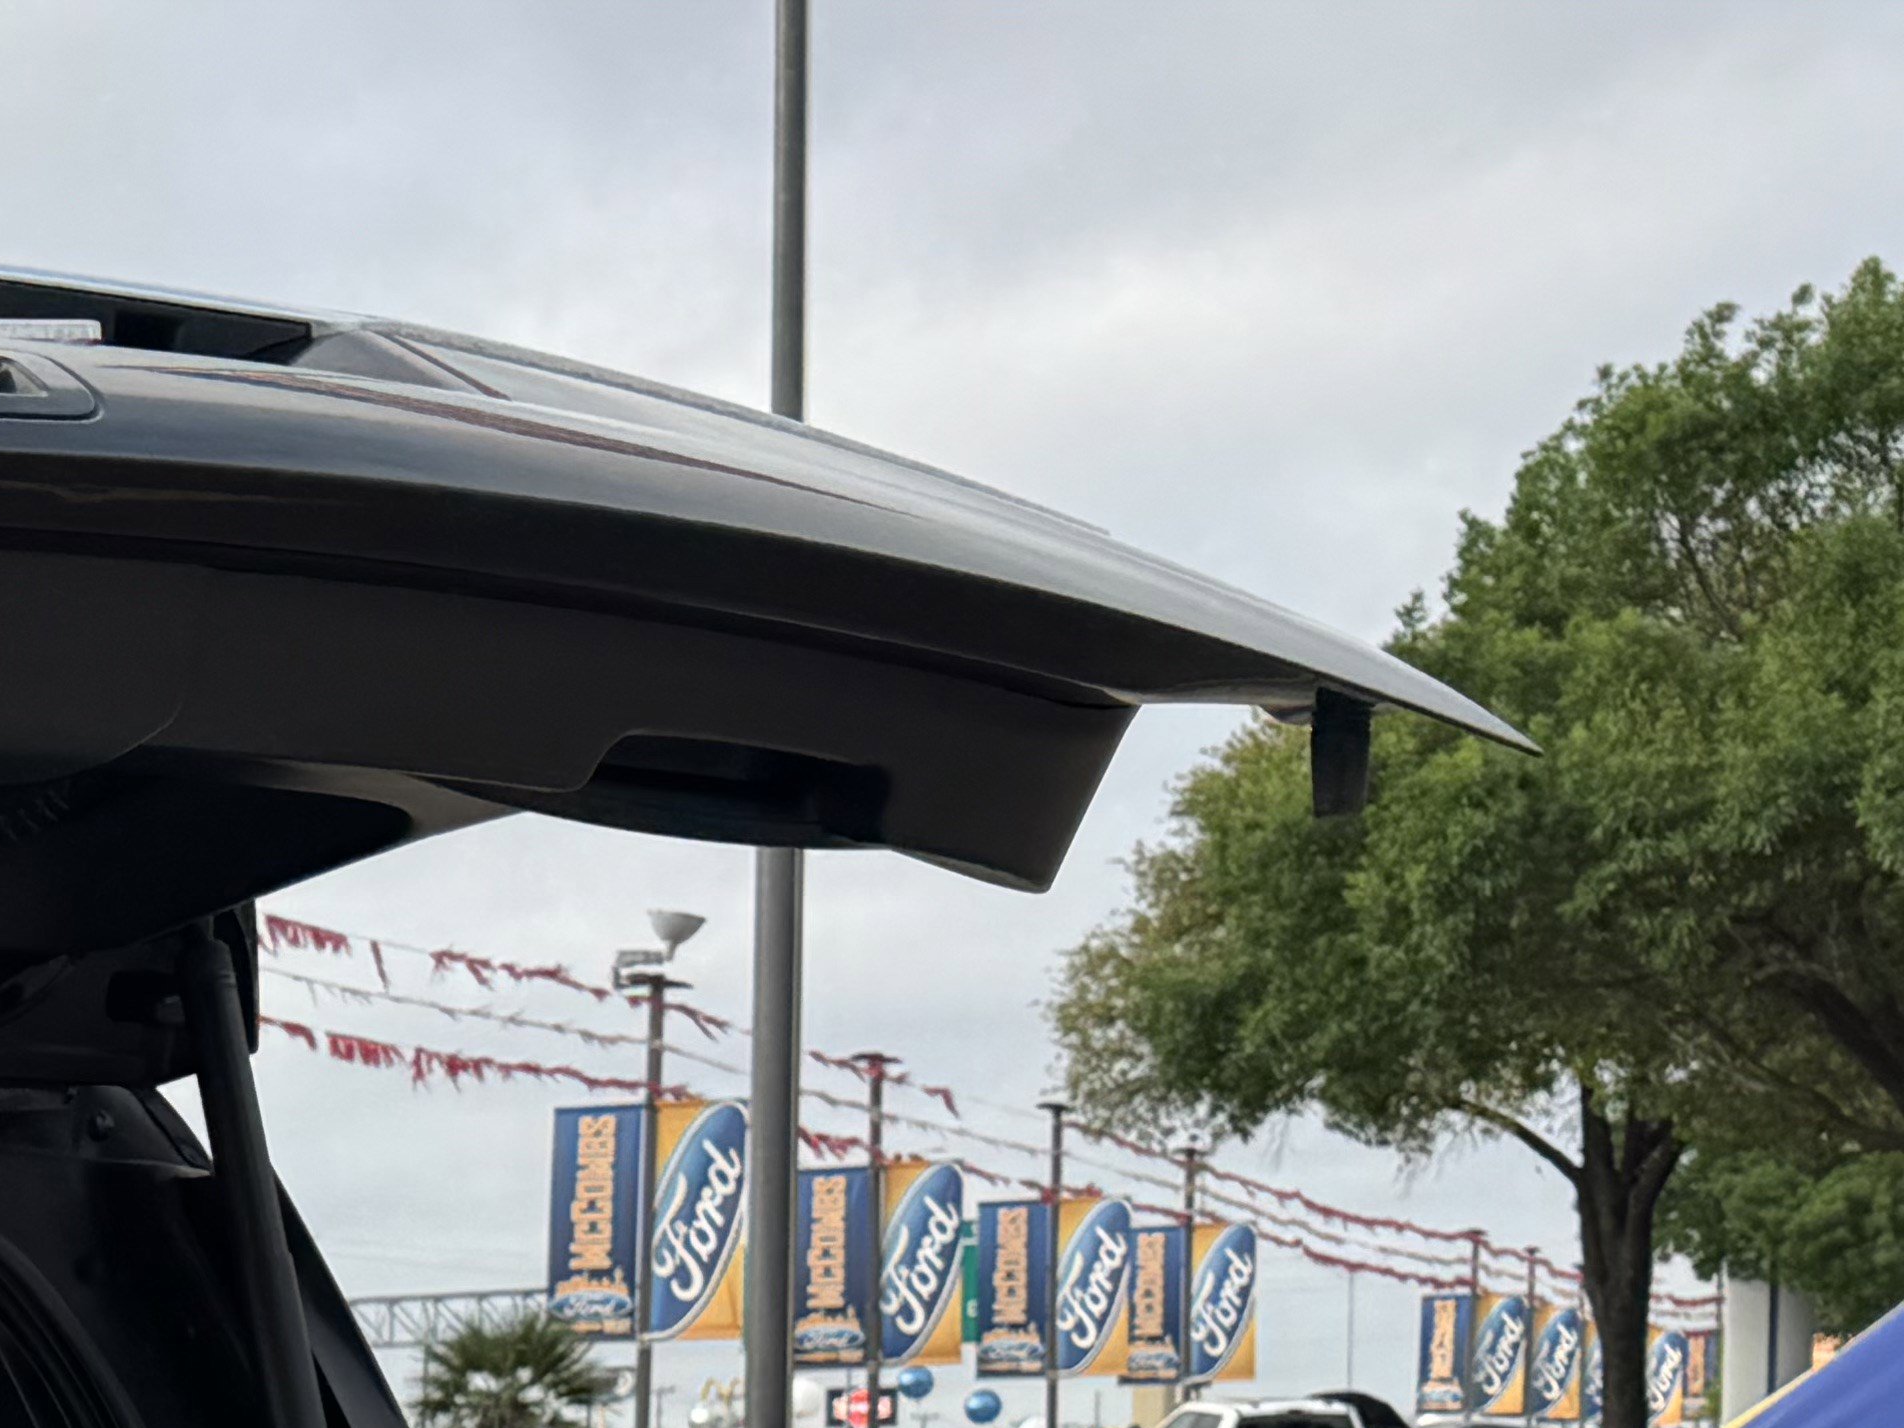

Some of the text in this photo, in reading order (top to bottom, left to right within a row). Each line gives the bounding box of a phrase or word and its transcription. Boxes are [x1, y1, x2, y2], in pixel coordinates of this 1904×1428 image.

[653, 1139, 742, 1302] Ford
[880, 1195, 960, 1335] Ford
[1057, 1225, 1127, 1349] Ford
[1191, 1247, 1253, 1357] Ford
[1473, 1311, 1525, 1396] Ford
[1533, 1322, 1579, 1400] Ford
